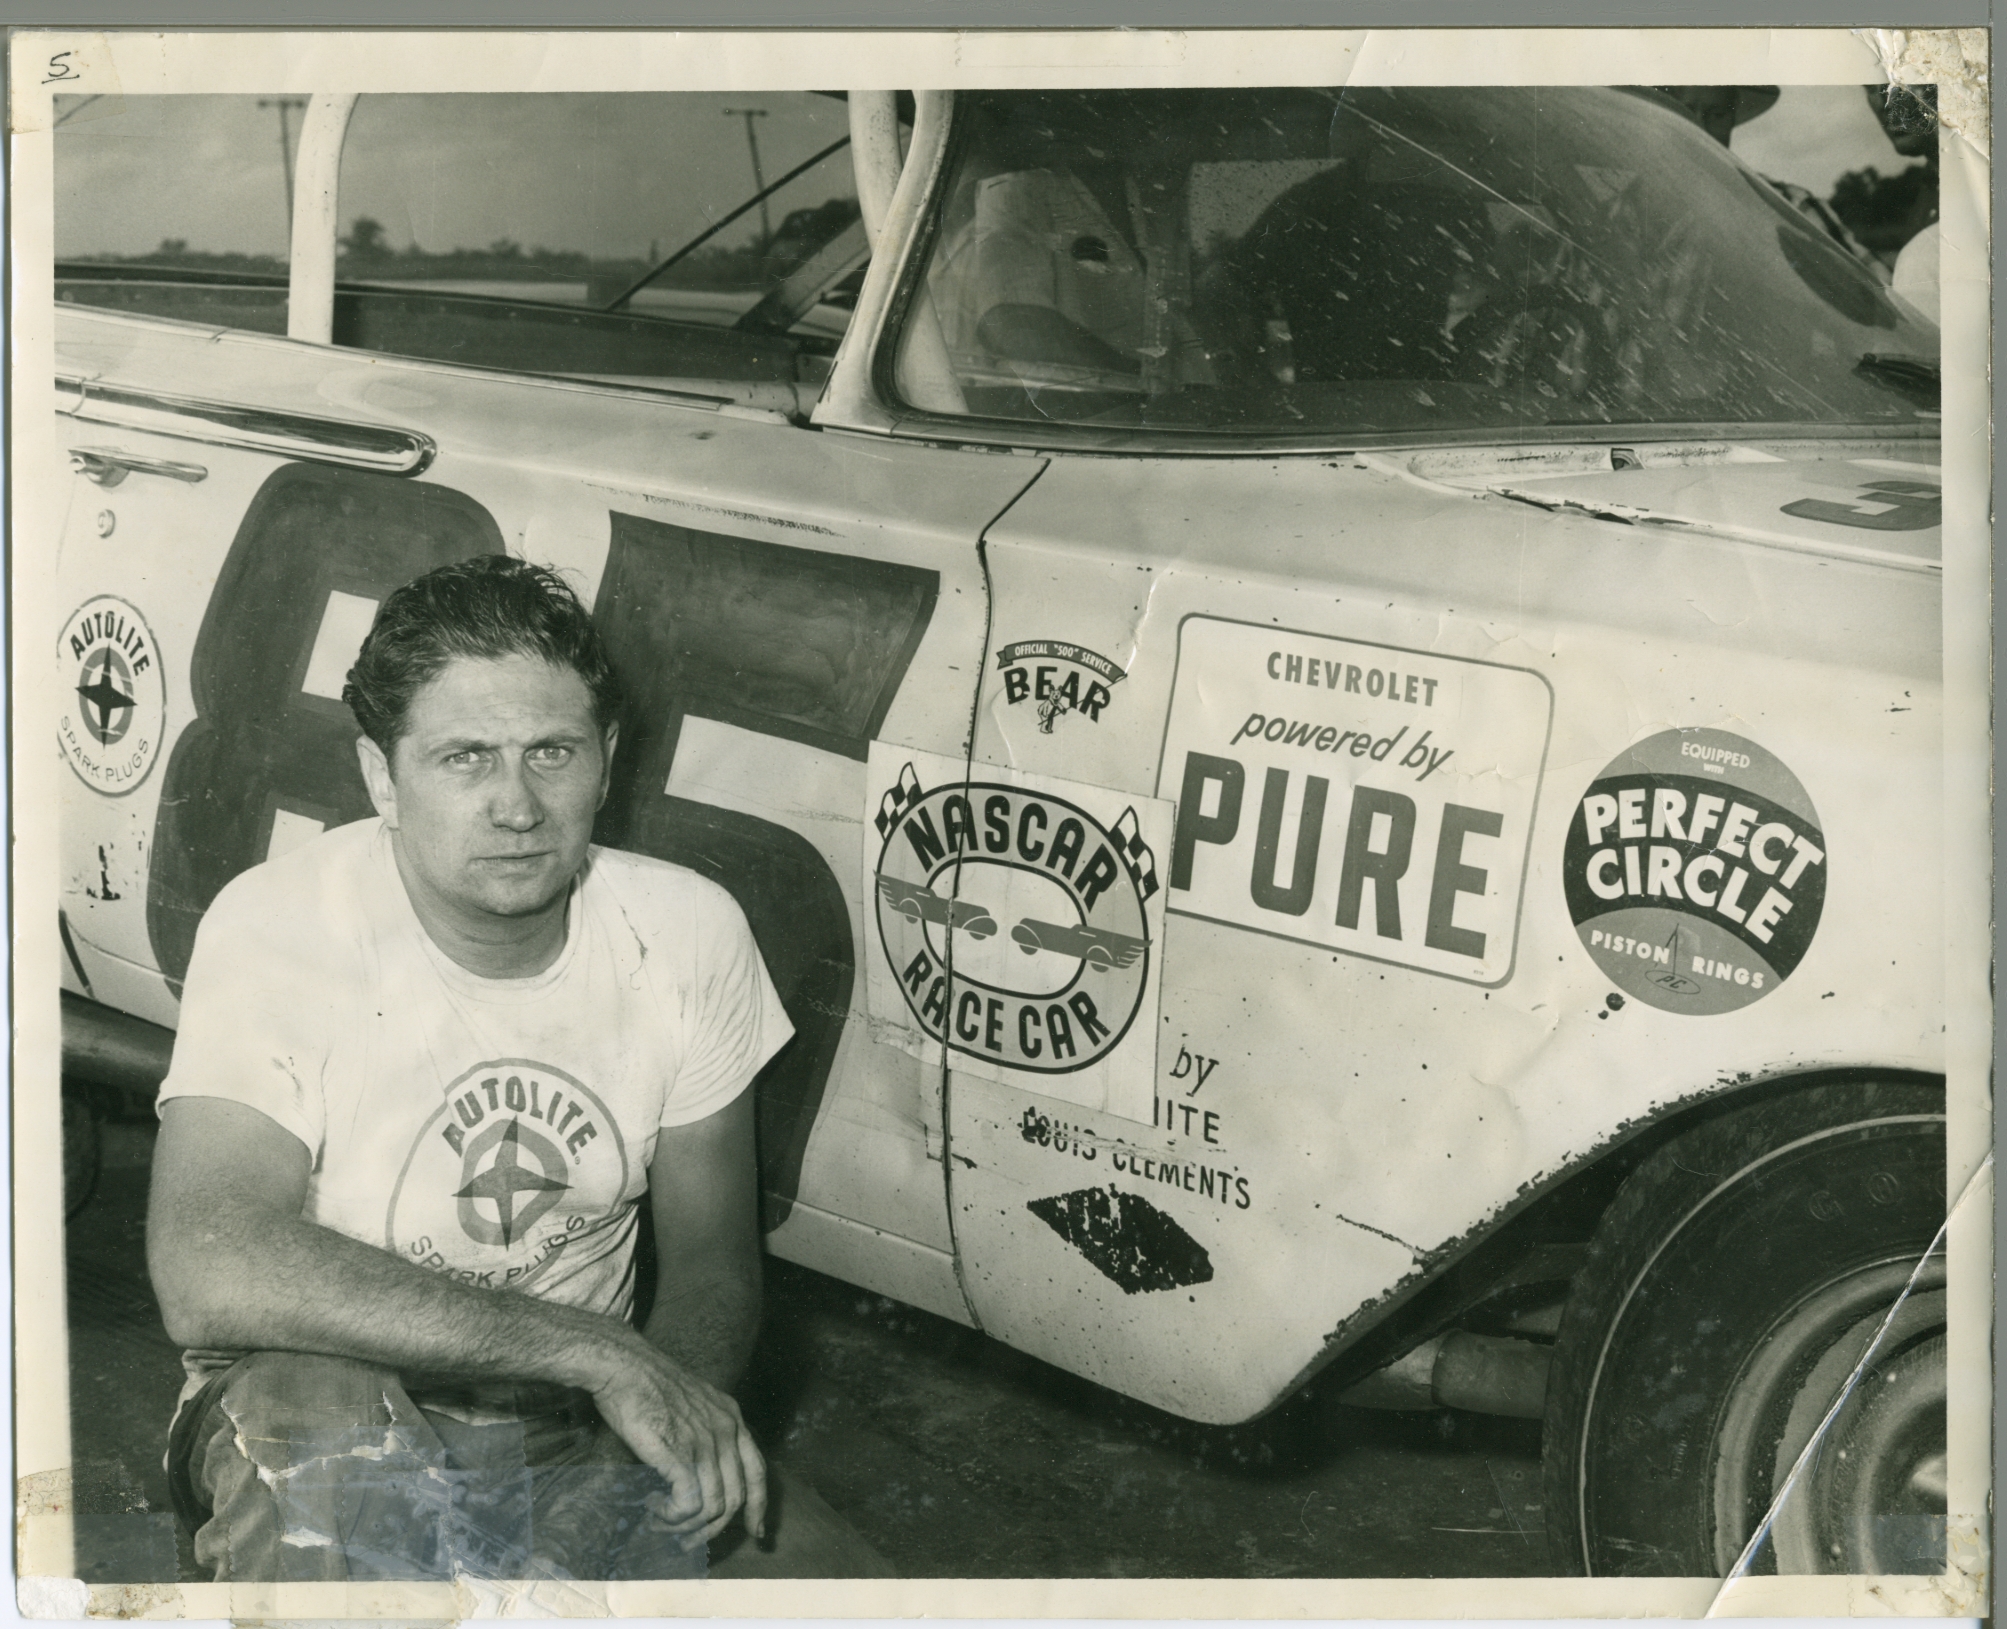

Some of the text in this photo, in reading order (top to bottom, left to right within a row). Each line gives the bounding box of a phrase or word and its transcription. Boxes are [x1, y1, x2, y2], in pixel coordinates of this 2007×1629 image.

[46, 51, 72, 79] 5
[69, 610, 150, 677] AUTOLITE
[1014, 643, 1048, 656] OFFICIAL
[1081, 652, 1112, 675] SERVICE
[1003, 665, 1111, 724] BEAR
[1266, 650, 1439, 707] CHEVROLET
[60, 715, 149, 782] SPARK PLUGS
[1229, 712, 1455, 782] powered by
[1680, 741, 1751, 769] EQUIPPED
[1703, 762, 1725, 775] WITH
[902, 794, 1118, 914] NASCAR
[1169, 750, 1505, 960] PURE
[1583, 787, 1826, 890] PERFECT
[1586, 845, 1794, 945] CIRCLE
[1590, 929, 1765, 990] PISTON RINGS
[902, 948, 1112, 1061] RACE CAR
[1169, 1043, 1220, 1098] by
[441, 1075, 598, 1159] AUTOLITE
